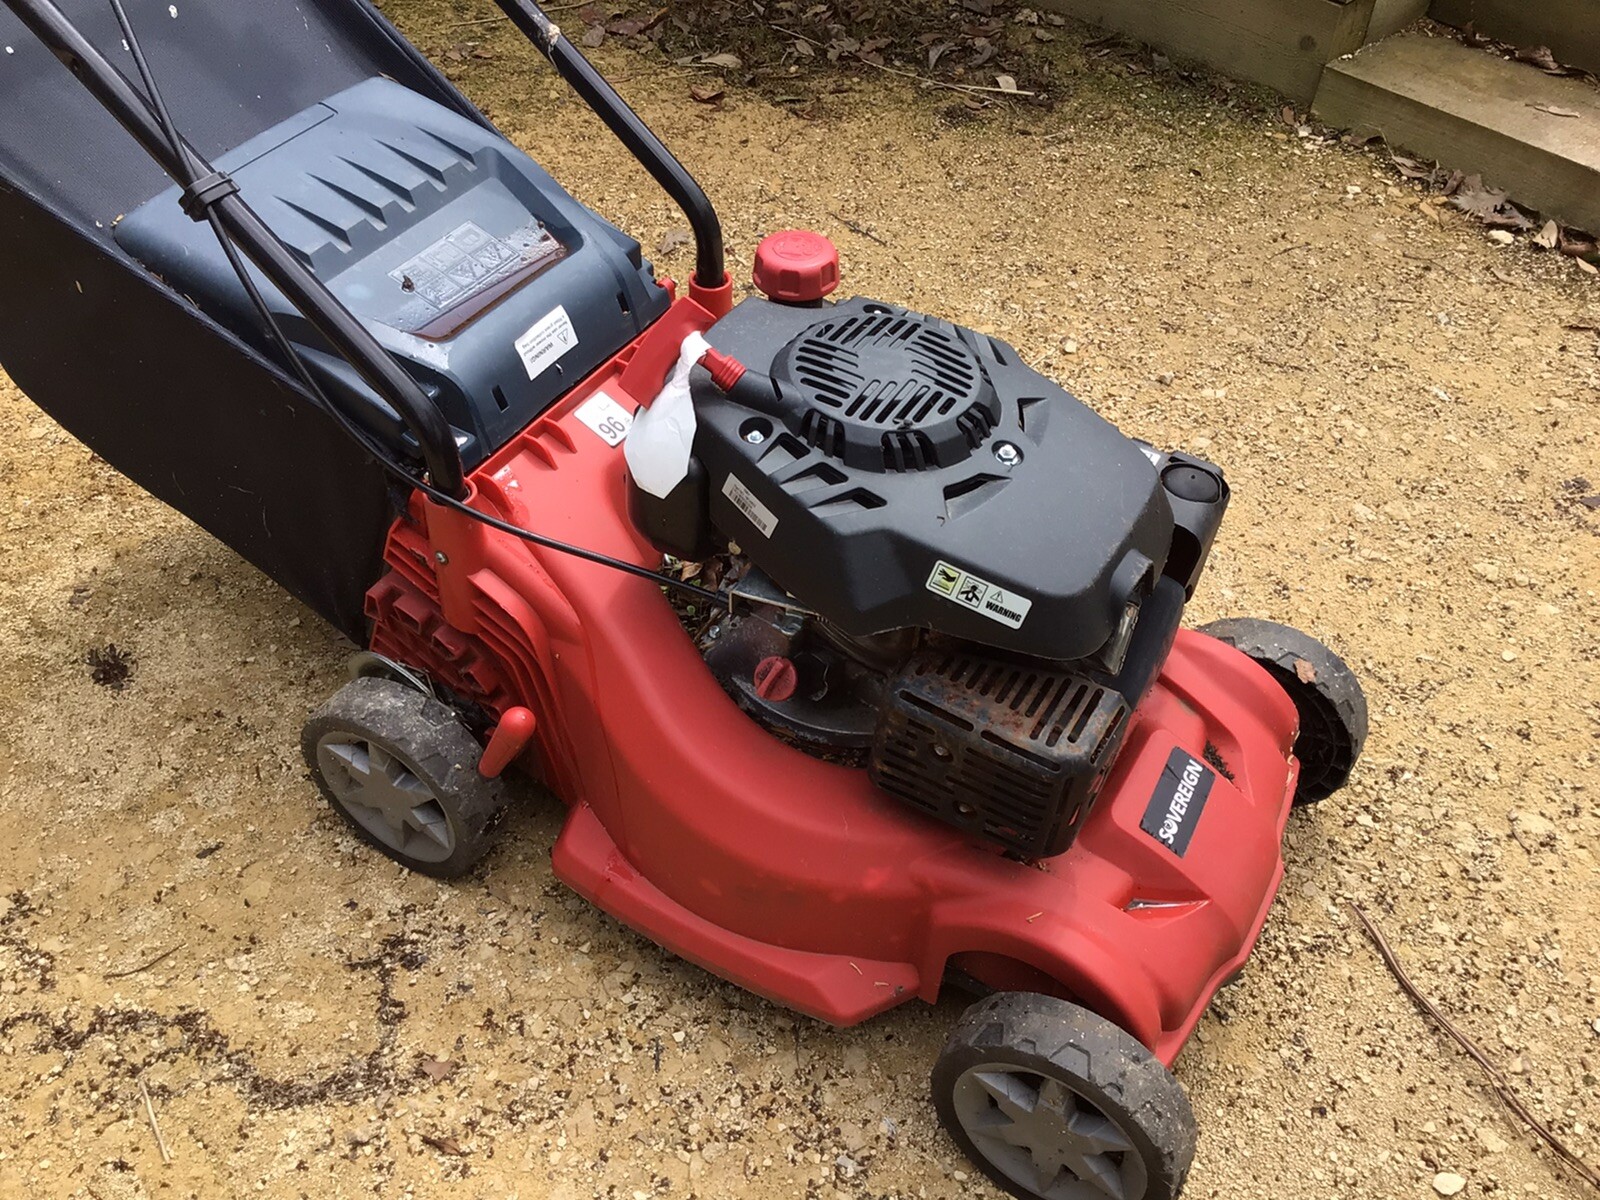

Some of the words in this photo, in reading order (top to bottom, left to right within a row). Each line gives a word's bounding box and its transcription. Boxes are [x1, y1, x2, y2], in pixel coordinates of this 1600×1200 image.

[598, 416, 626, 439] 96
[985, 600, 1022, 623] WARNING
[1158, 759, 1204, 845] SOVEREIGN
